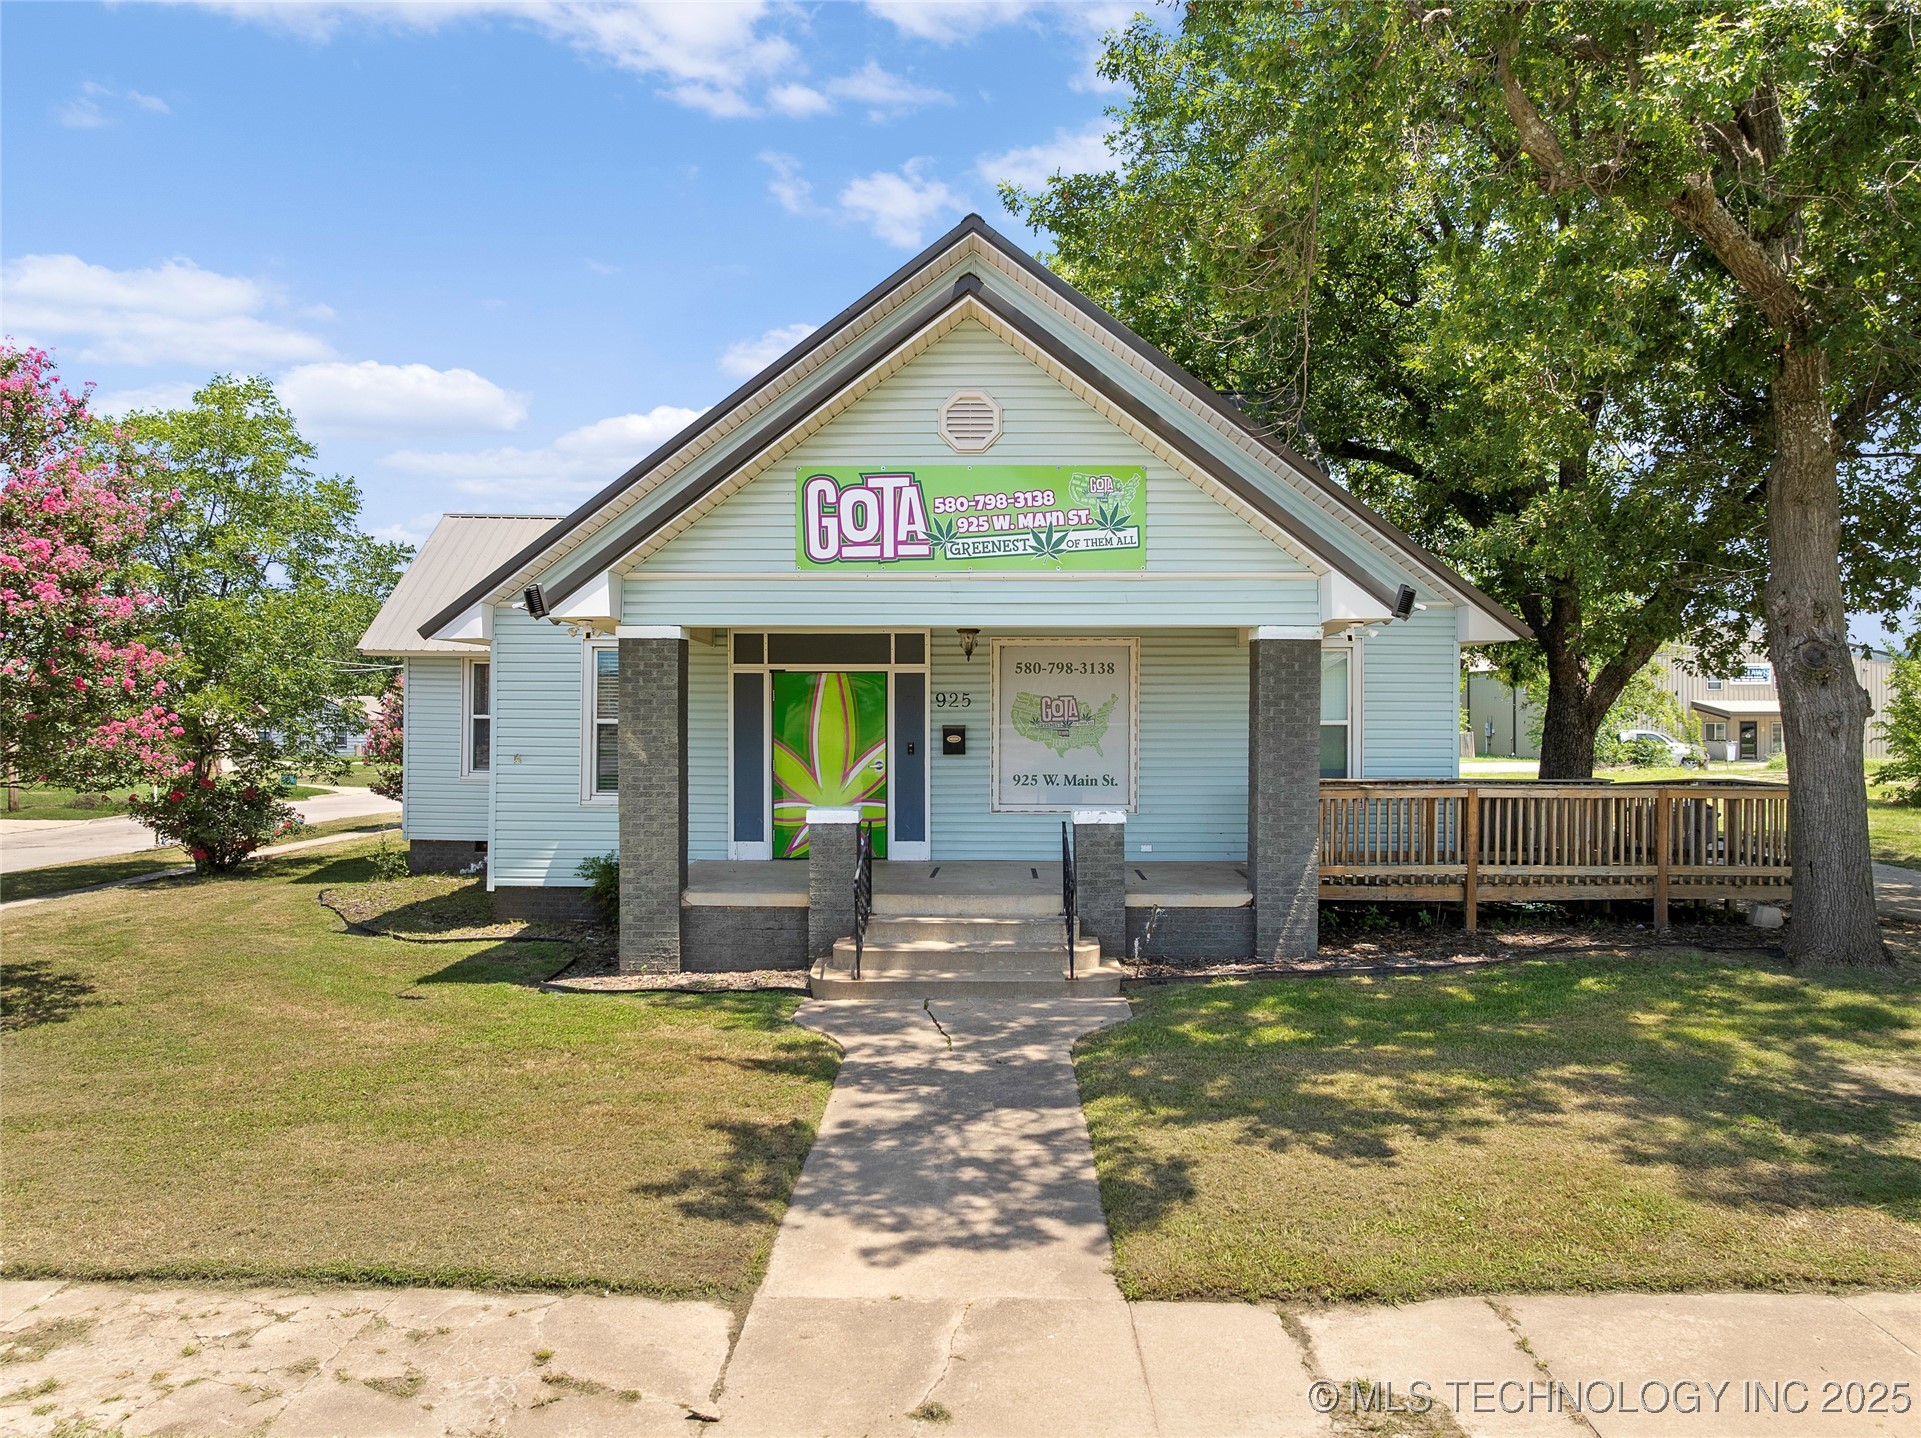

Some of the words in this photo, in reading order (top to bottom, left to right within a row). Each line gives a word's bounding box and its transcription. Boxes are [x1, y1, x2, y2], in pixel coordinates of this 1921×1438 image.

[934, 489, 1055, 514] 580-798-3138
[957, 515, 990, 534] 925
[992, 514, 1015, 531] W.
[1067, 508, 1094, 525] ST.
[950, 538, 1029, 556] GREENEST
[1066, 539, 1080, 548] OF
[1084, 537, 1113, 547] THEM
[1117, 535, 1137, 545] ALL
[1015, 662, 1115, 675] 580-798-3138
[935, 692, 971, 708] 925
[1013, 774, 1038, 786] 925
[1042, 774, 1059, 786] W.
[1063, 774, 1098, 787] Main
[1102, 774, 1118, 786] St.
